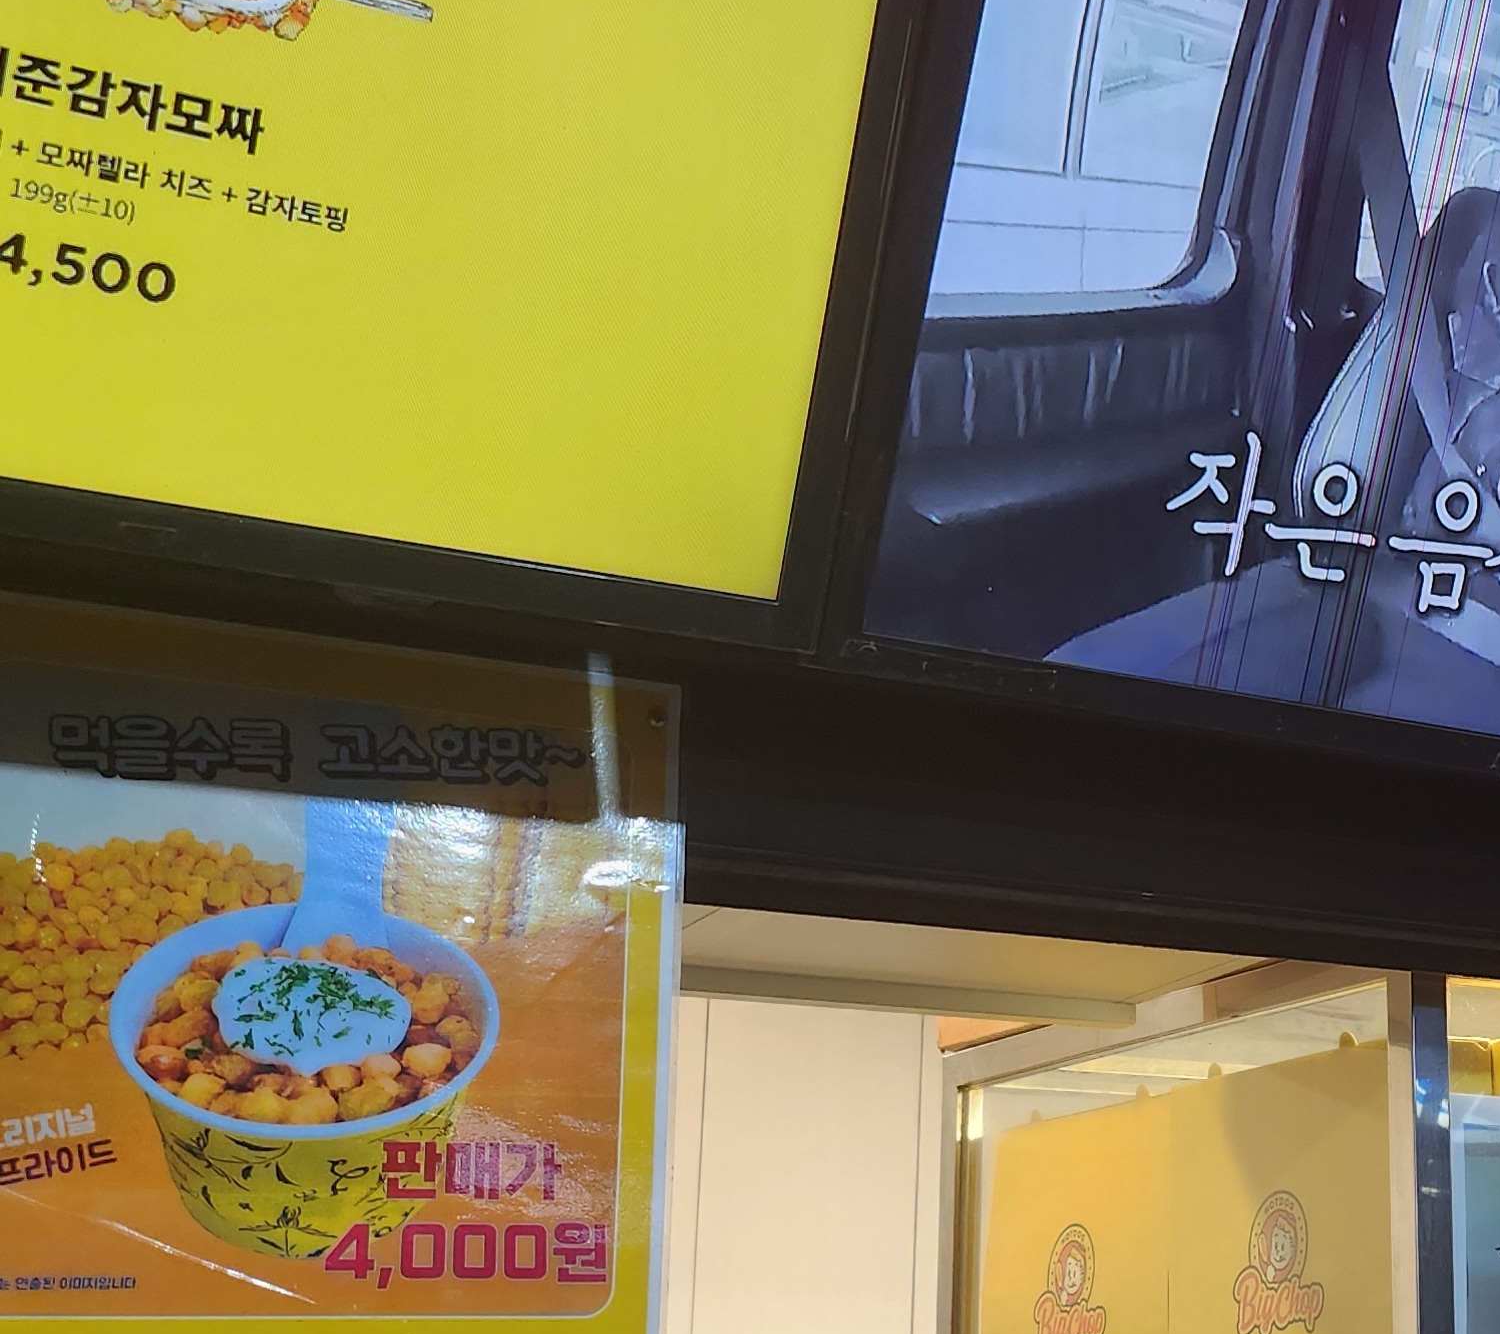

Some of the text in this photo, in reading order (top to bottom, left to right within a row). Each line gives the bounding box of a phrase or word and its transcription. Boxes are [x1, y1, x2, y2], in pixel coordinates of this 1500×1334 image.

[11, 178, 136, 225] 199g(±10)
[161, 169, 213, 200] 치즈
[246, 187, 349, 233] 감자토핑
[0, 233, 176, 303] 4,500
[1164, 431, 1377, 584] 작은
[49, 715, 293, 780] 먹을수록
[0, 1103, 96, 1148] 리지널
[0, 1139, 118, 1186] 프라이드
[381, 1140, 563, 1202] 판매가
[59, 1277, 137, 1290] 이미지입니다
[325, 1222, 608, 1291] 4,000원
